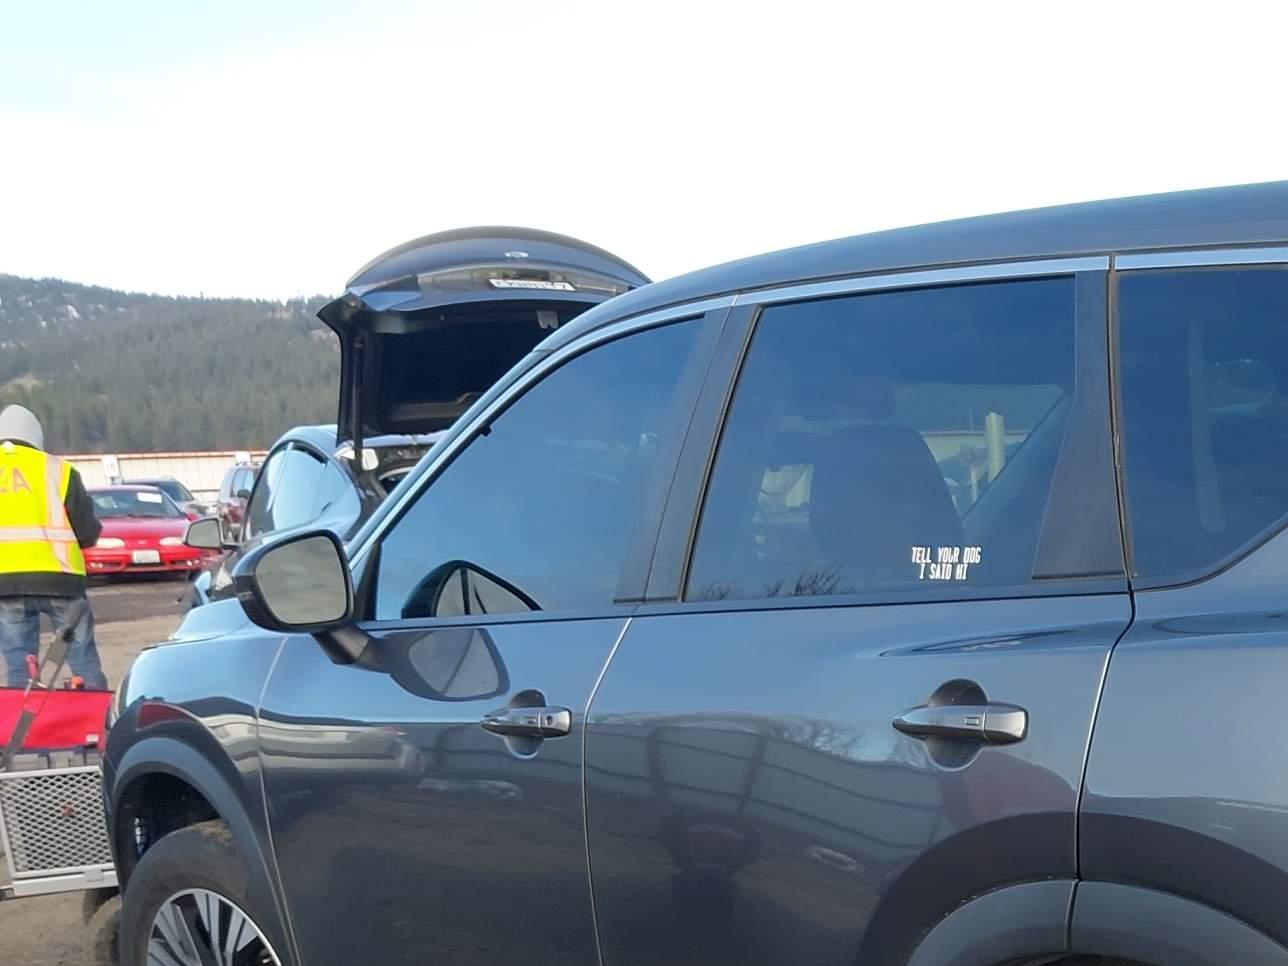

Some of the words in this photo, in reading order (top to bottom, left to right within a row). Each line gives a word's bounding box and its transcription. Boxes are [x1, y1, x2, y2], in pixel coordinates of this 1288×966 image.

[0, 468, 33, 495] A
[911, 546, 932, 563] TELL
[938, 546, 960, 563] YOUR
[962, 546, 982, 563] DOG
[919, 563, 926, 579] I
[929, 562, 953, 580] SAID
[955, 563, 969, 580] HI
